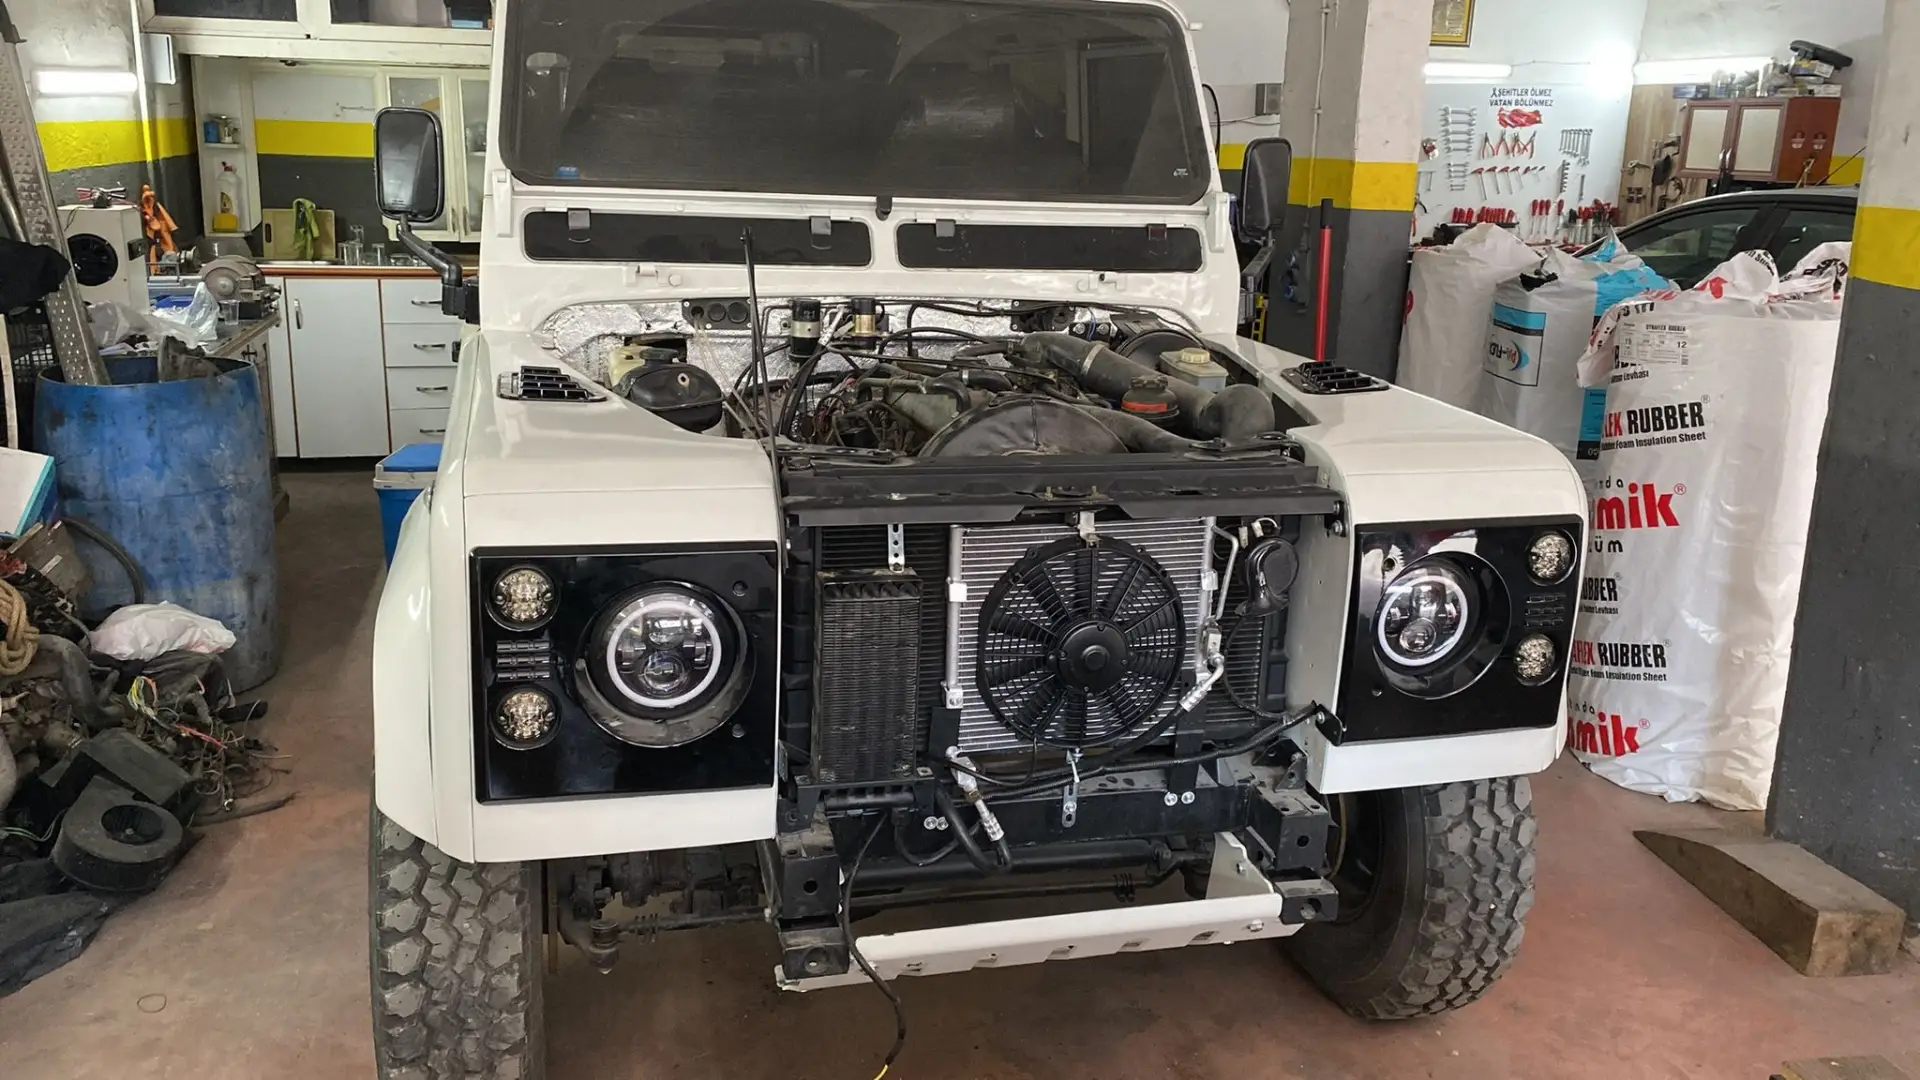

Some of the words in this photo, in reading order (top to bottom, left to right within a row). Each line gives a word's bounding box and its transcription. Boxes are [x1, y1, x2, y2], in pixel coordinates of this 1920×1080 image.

[1530, 85, 1552, 96] ÖLMEZ
[1514, 97, 1553, 106] BÖLÜNMEZ
[1677, 341, 1688, 349] 12
[1627, 401, 1705, 435] RUBBER
[1615, 439, 1635, 449] Foam
[1636, 433, 1676, 447] Insulation
[1678, 431, 1707, 442] Sheet
[1597, 642, 1667, 668] RUBBER
[1605, 670, 1642, 682] Insulation
[1643, 672, 1667, 682] Sheet
